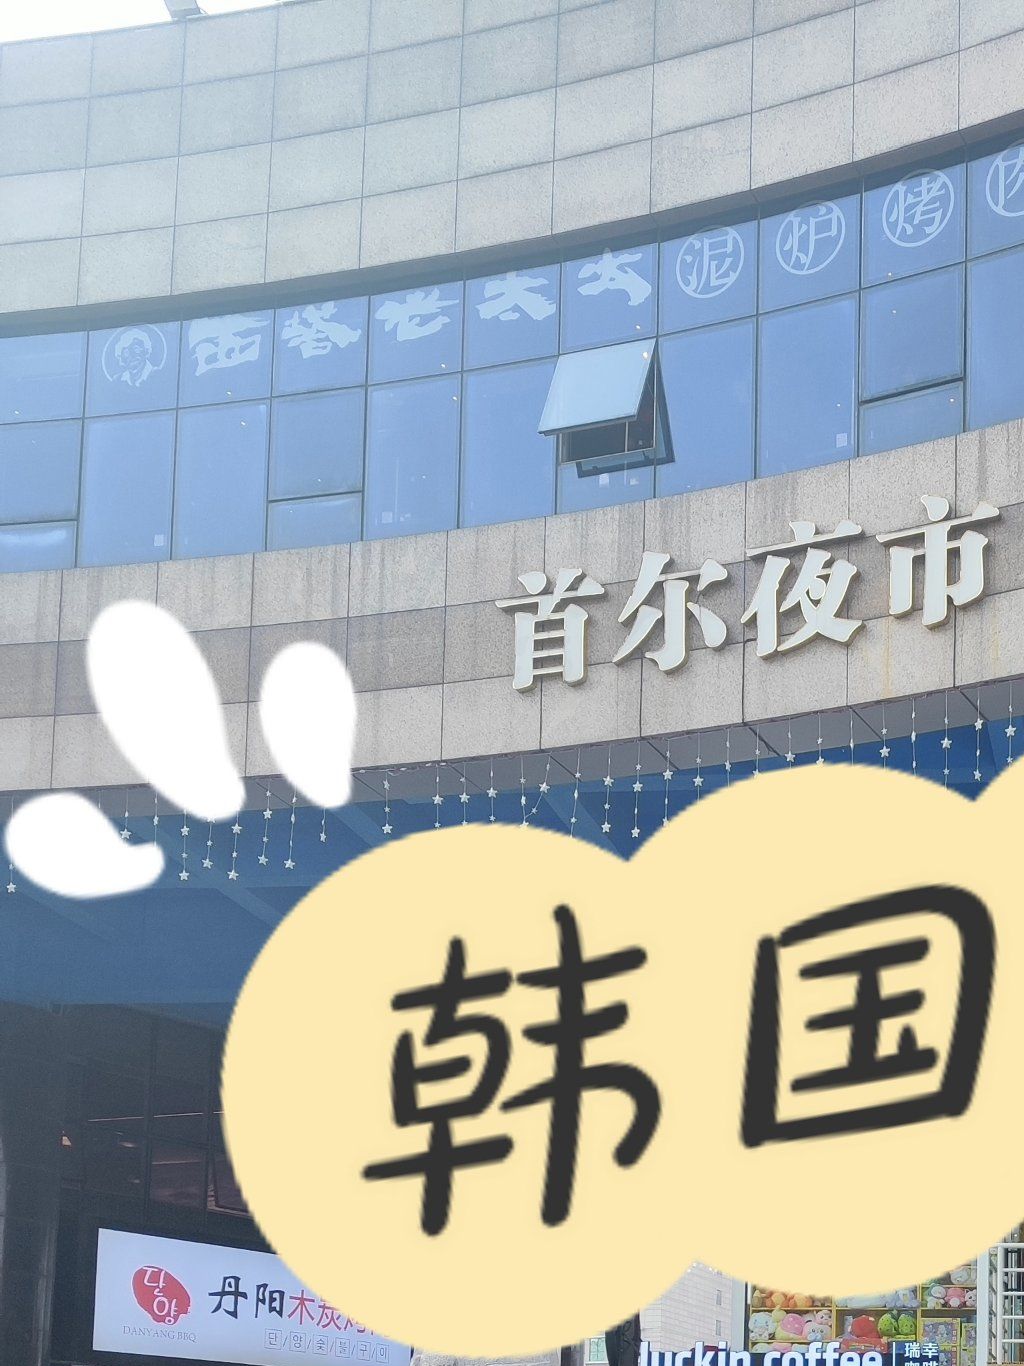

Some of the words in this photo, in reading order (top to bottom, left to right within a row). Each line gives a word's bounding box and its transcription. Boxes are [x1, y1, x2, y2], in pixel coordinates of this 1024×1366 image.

[494, 494, 1000, 693] 首尔夜市
[122, 1325, 176, 1341] DANYANG
[177, 1330, 197, 1343] BBQ
[904, 1342, 939, 1359] 瑞幸
